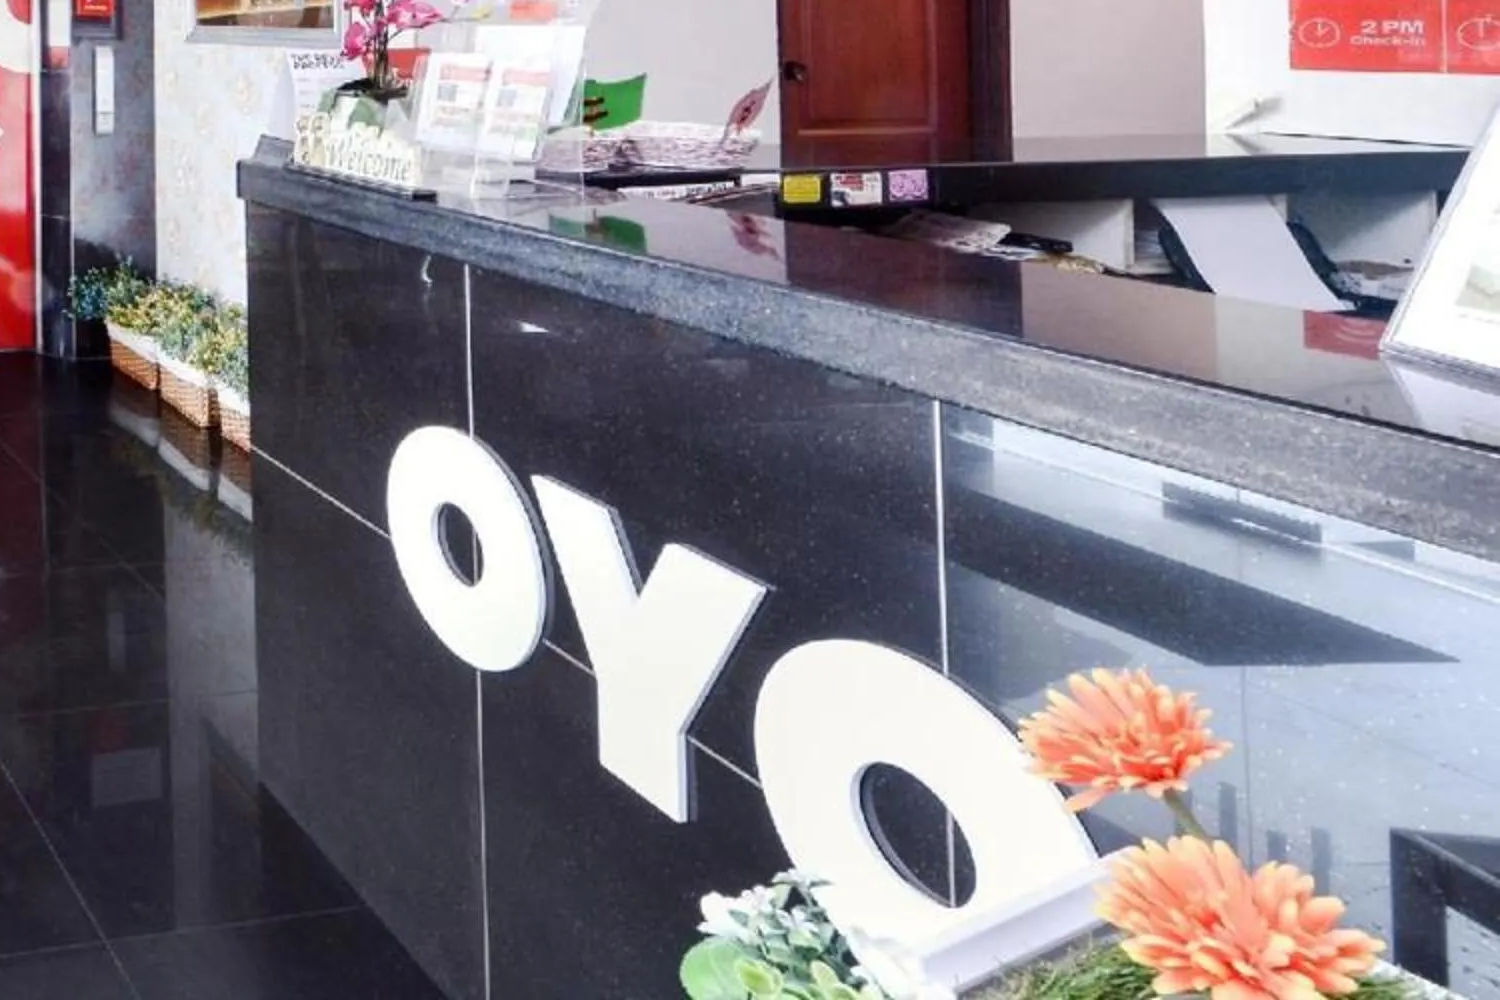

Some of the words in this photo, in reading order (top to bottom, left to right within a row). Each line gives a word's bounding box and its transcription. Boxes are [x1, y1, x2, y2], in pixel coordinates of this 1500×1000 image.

[1361, 19, 1378, 34] 2
[1382, 19, 1425, 34] PM
[387, 424, 1100, 967] OYO
